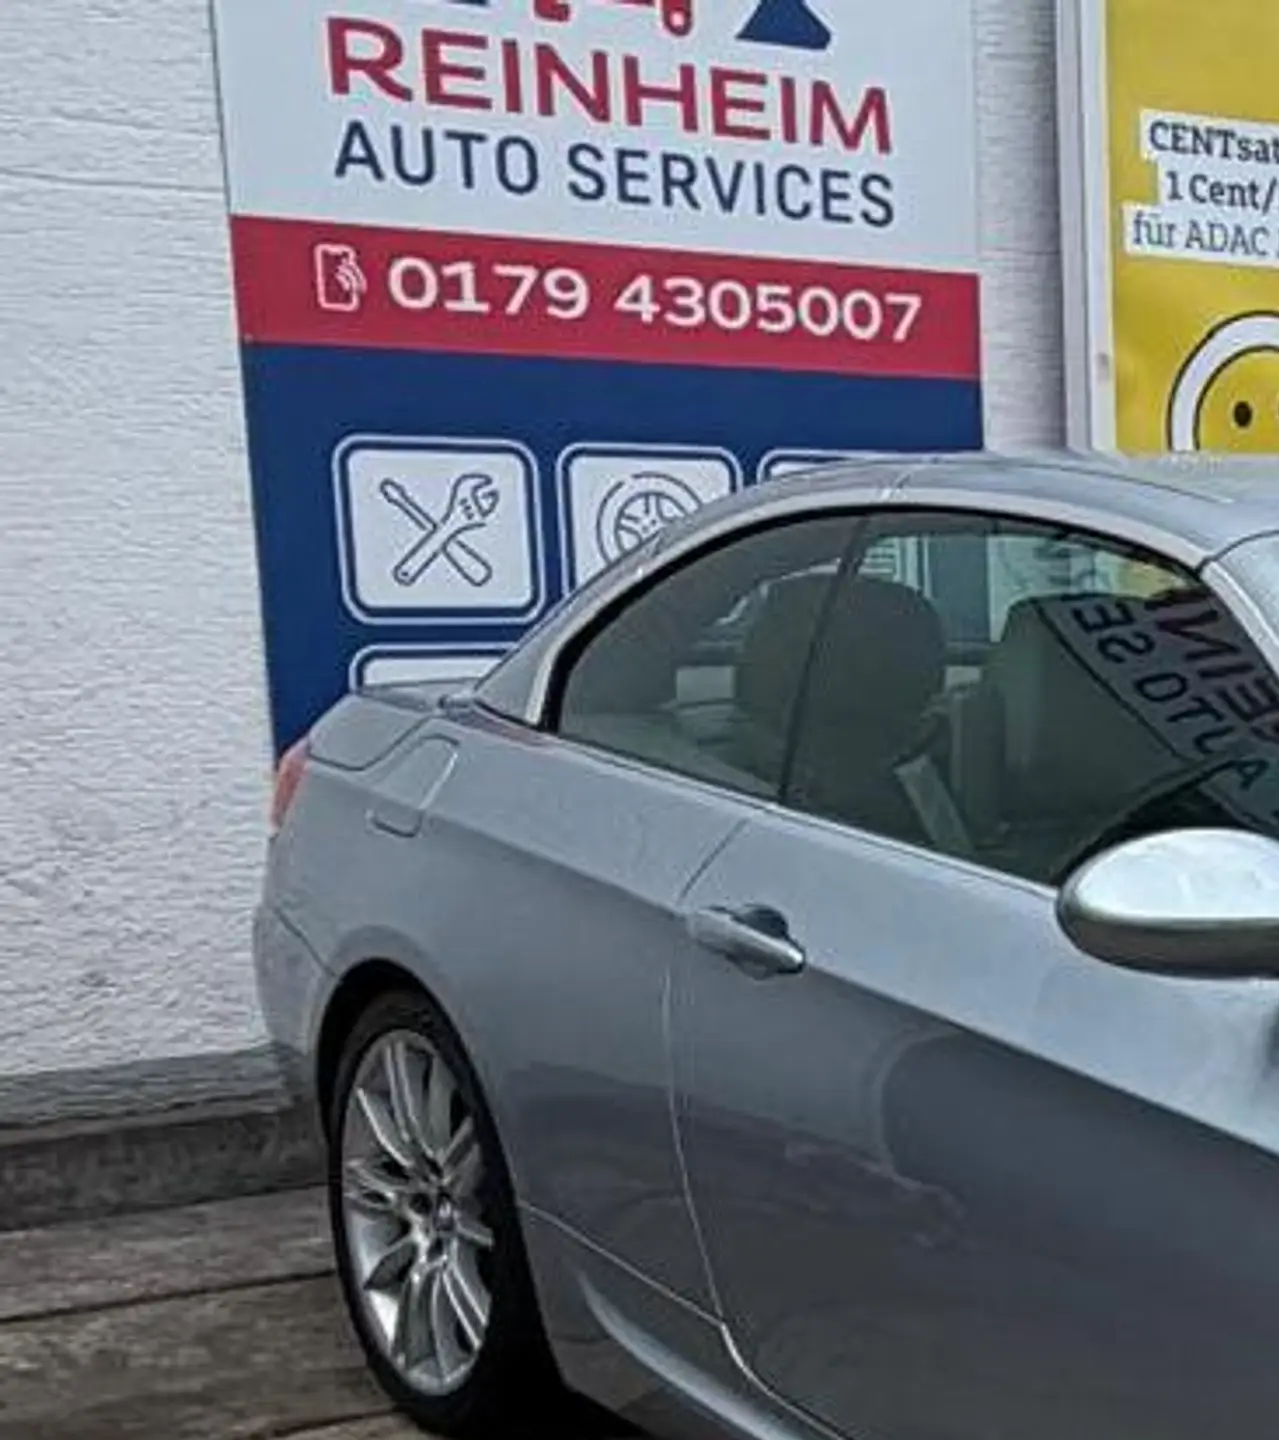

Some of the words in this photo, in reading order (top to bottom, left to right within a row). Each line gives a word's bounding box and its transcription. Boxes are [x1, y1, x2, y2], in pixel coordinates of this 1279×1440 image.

[327, 17, 892, 154] REINHEIM
[334, 120, 539, 195] AUTO
[566, 140, 894, 228] SERVICES
[1165, 171, 1182, 201] 1
[1132, 210, 1177, 250] für
[1184, 216, 1269, 260] ADAC
[388, 255, 590, 319] 0179
[614, 274, 922, 343] 4305007
